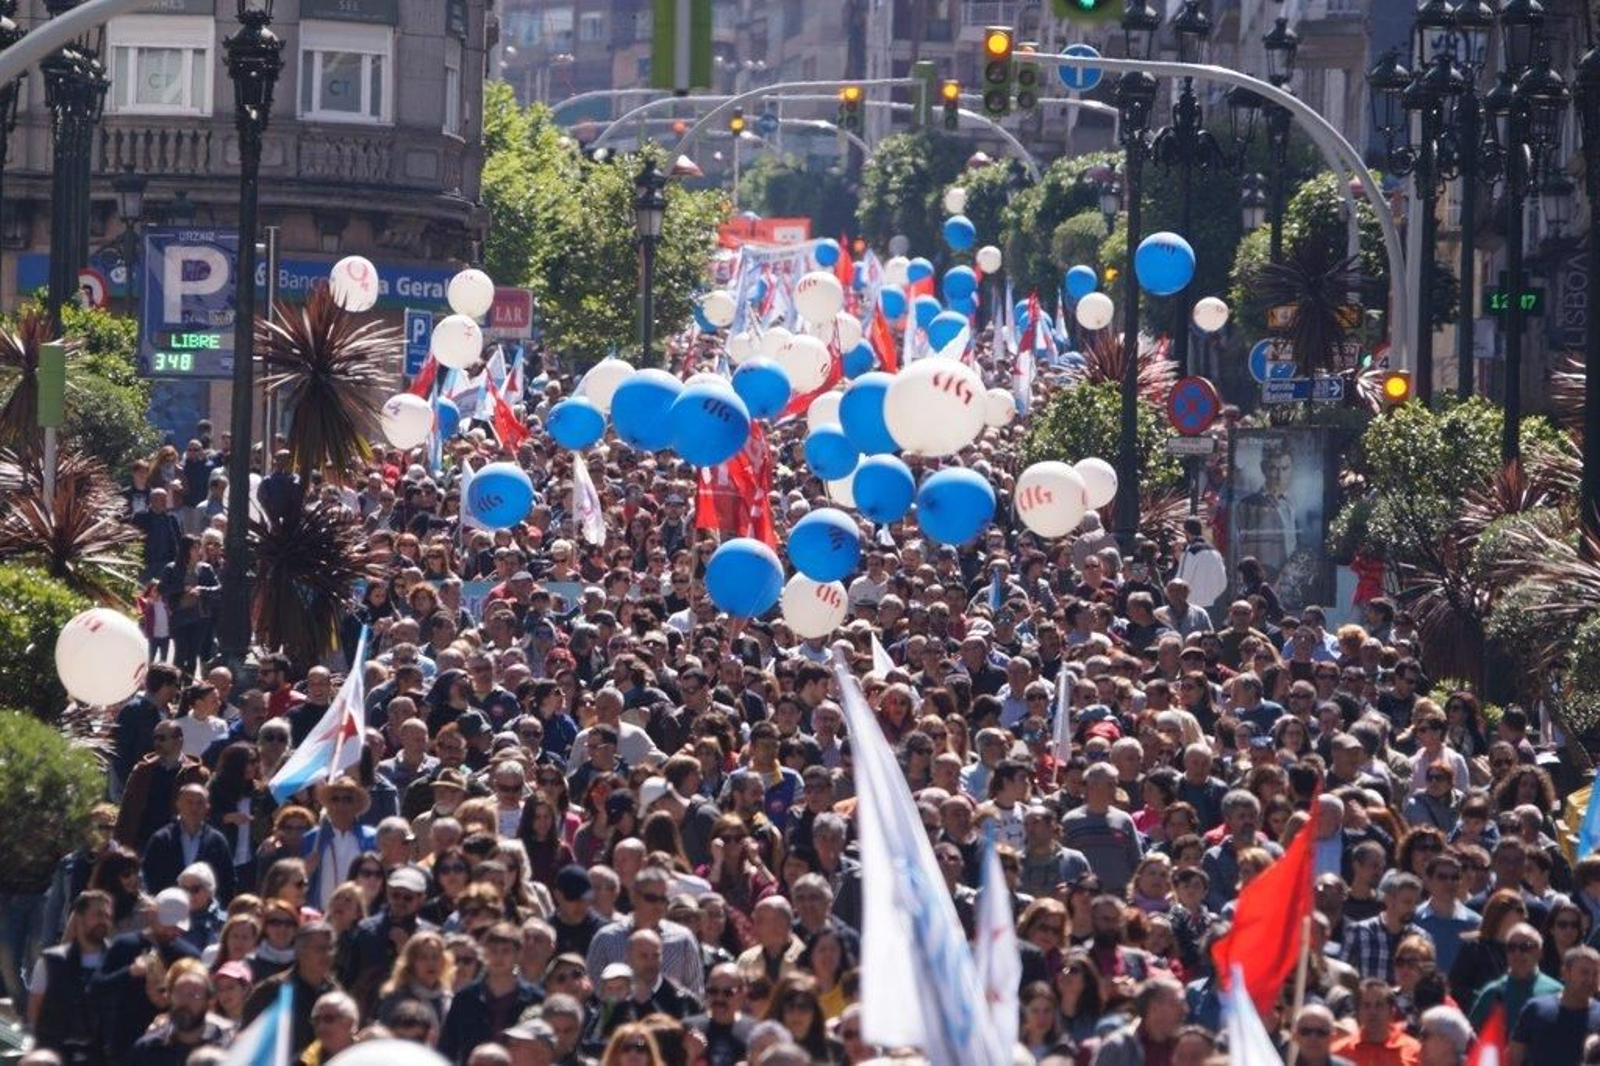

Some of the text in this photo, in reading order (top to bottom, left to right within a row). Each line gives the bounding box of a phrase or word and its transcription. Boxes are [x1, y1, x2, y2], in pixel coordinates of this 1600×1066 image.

[329, 80, 351, 96] CT
[164, 246, 229, 323] P
[396, 276, 448, 298] Geral
[413, 319, 425, 343] P
[171, 334, 221, 349] LIBRE
[155, 353, 192, 371] 348
